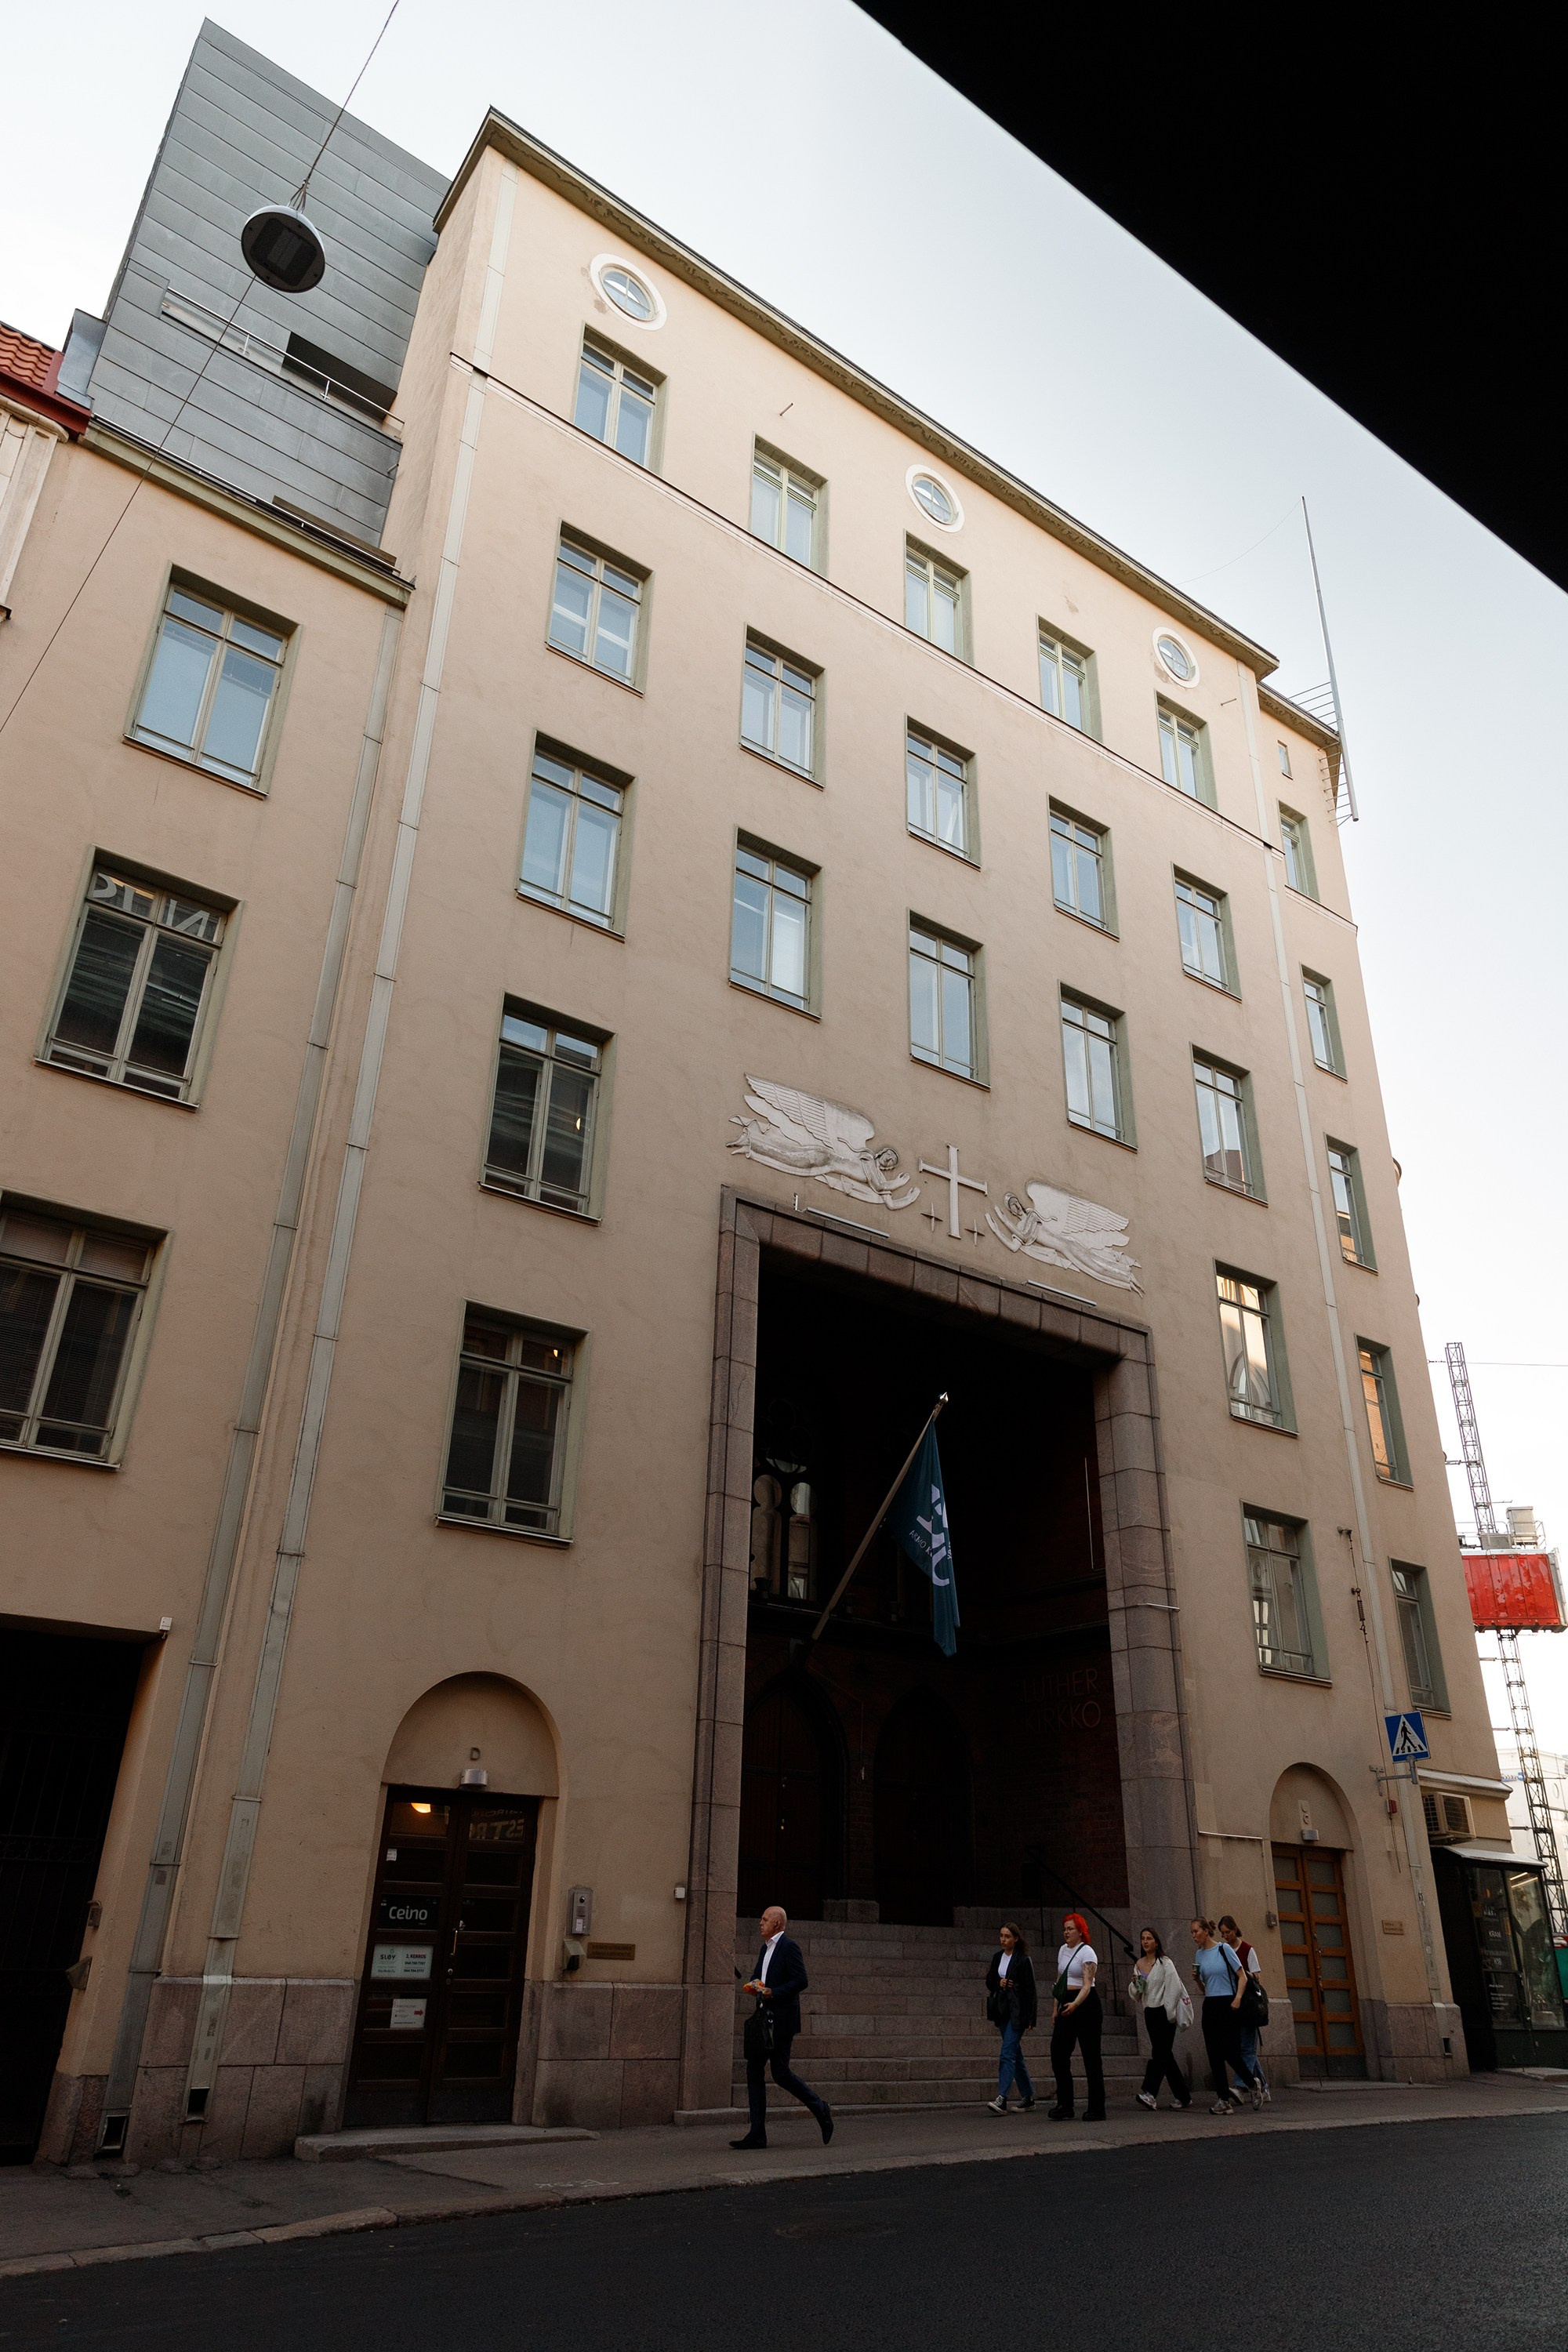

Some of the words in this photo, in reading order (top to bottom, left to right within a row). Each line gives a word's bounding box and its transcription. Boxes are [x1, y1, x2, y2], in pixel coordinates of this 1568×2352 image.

[909, 1530, 927, 1548] ARMO
[1022, 1668, 1099, 1703] LUTHER
[1024, 1700, 1102, 1732] KIRKKO
